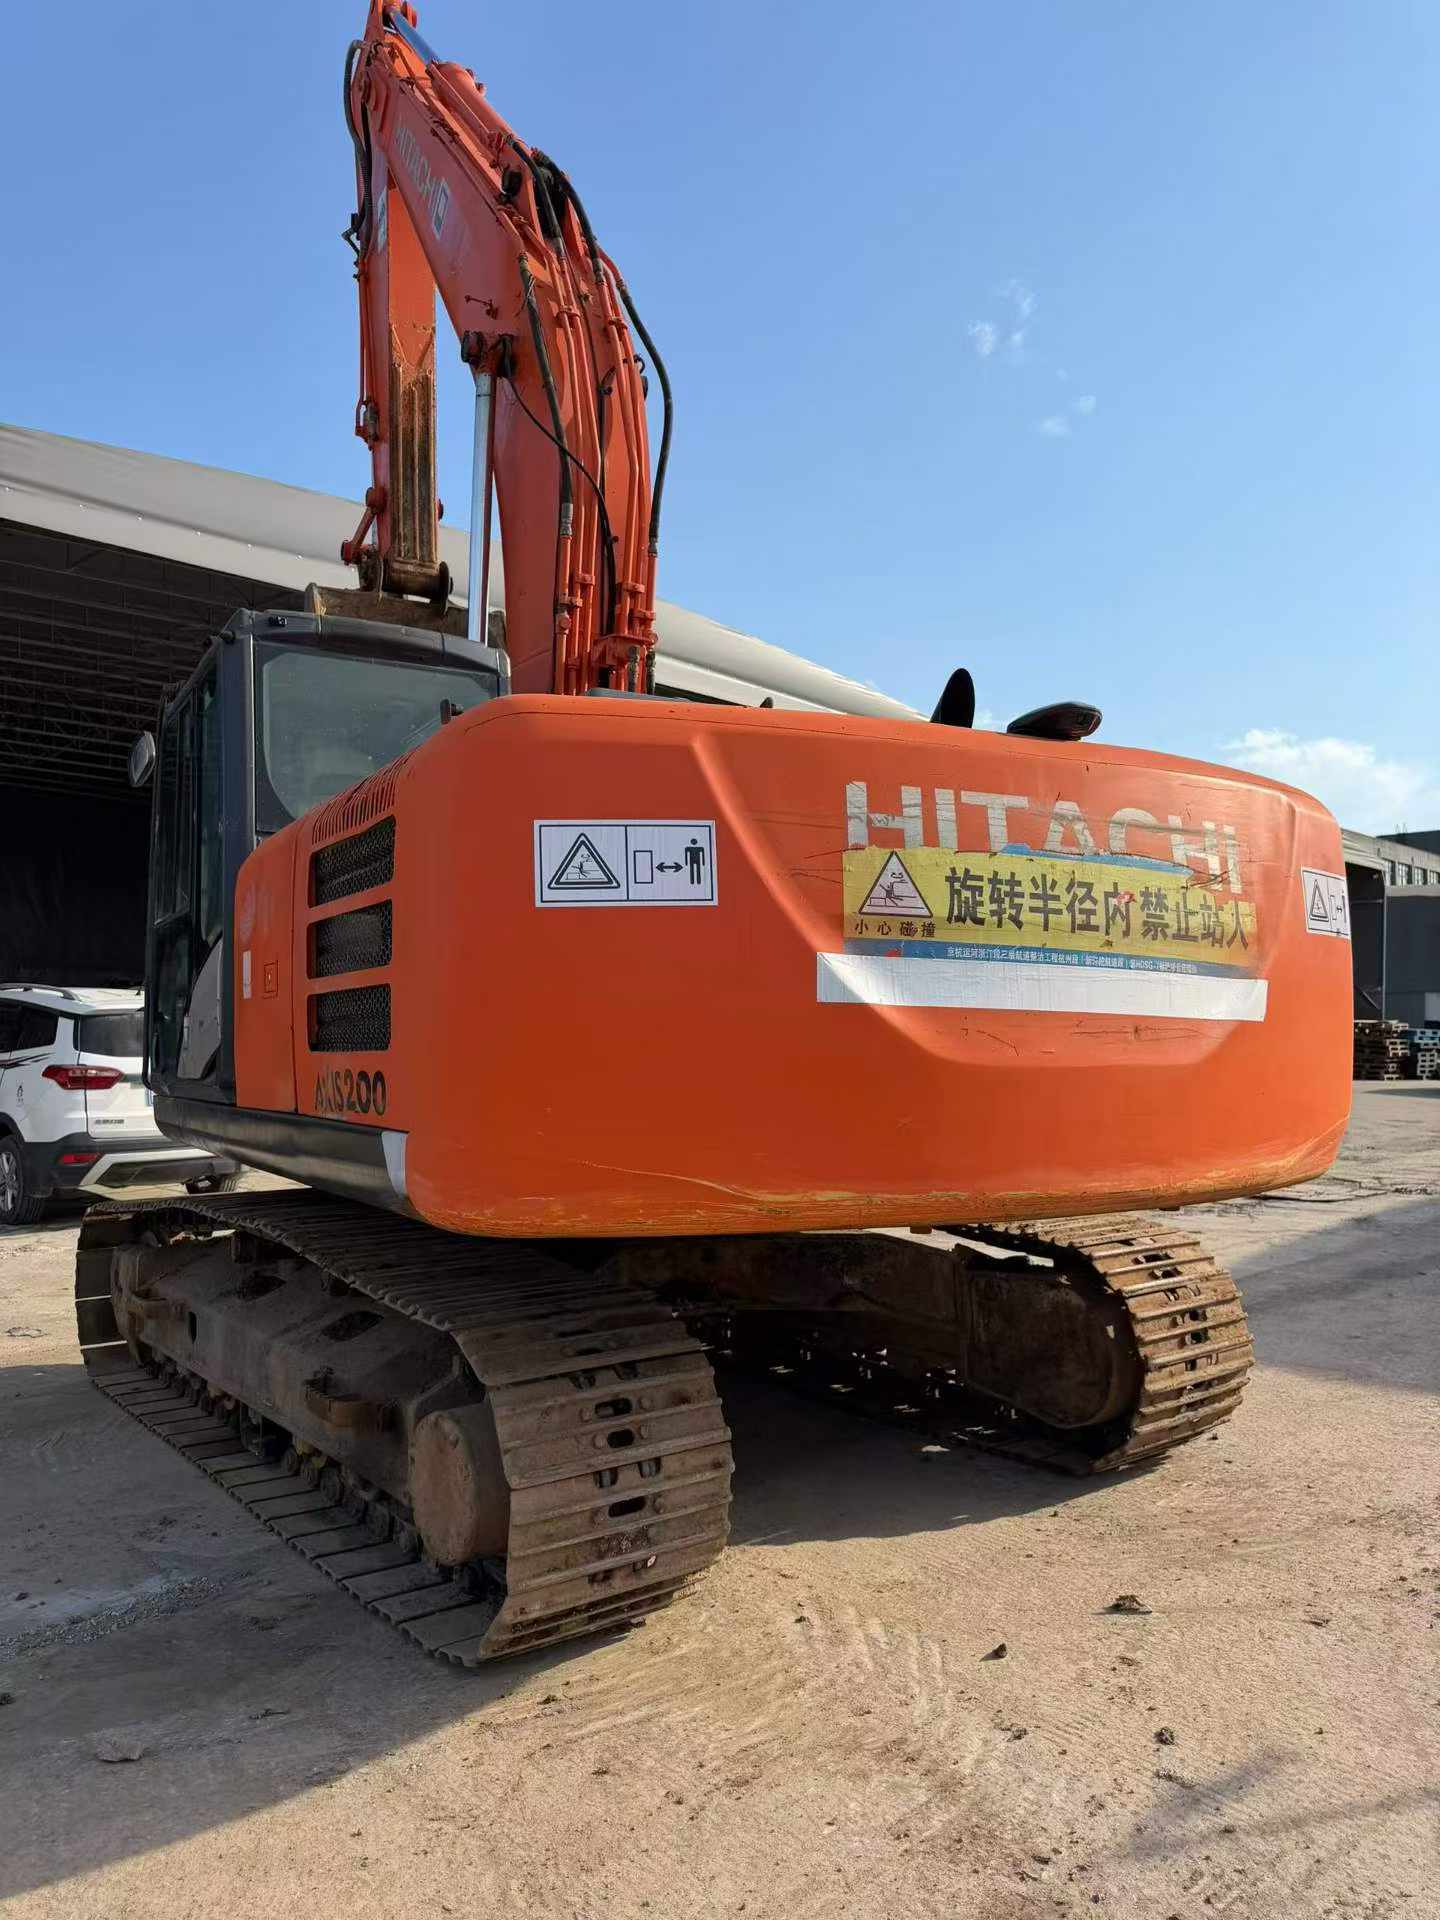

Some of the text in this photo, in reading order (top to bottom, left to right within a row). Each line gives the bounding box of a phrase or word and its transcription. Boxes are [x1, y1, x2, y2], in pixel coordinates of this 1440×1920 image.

[846, 781, 1243, 894] HITACHI
[854, 919, 936, 939] 小心碰撞
[945, 866, 1249, 951] 旋转半径内禁止站人
